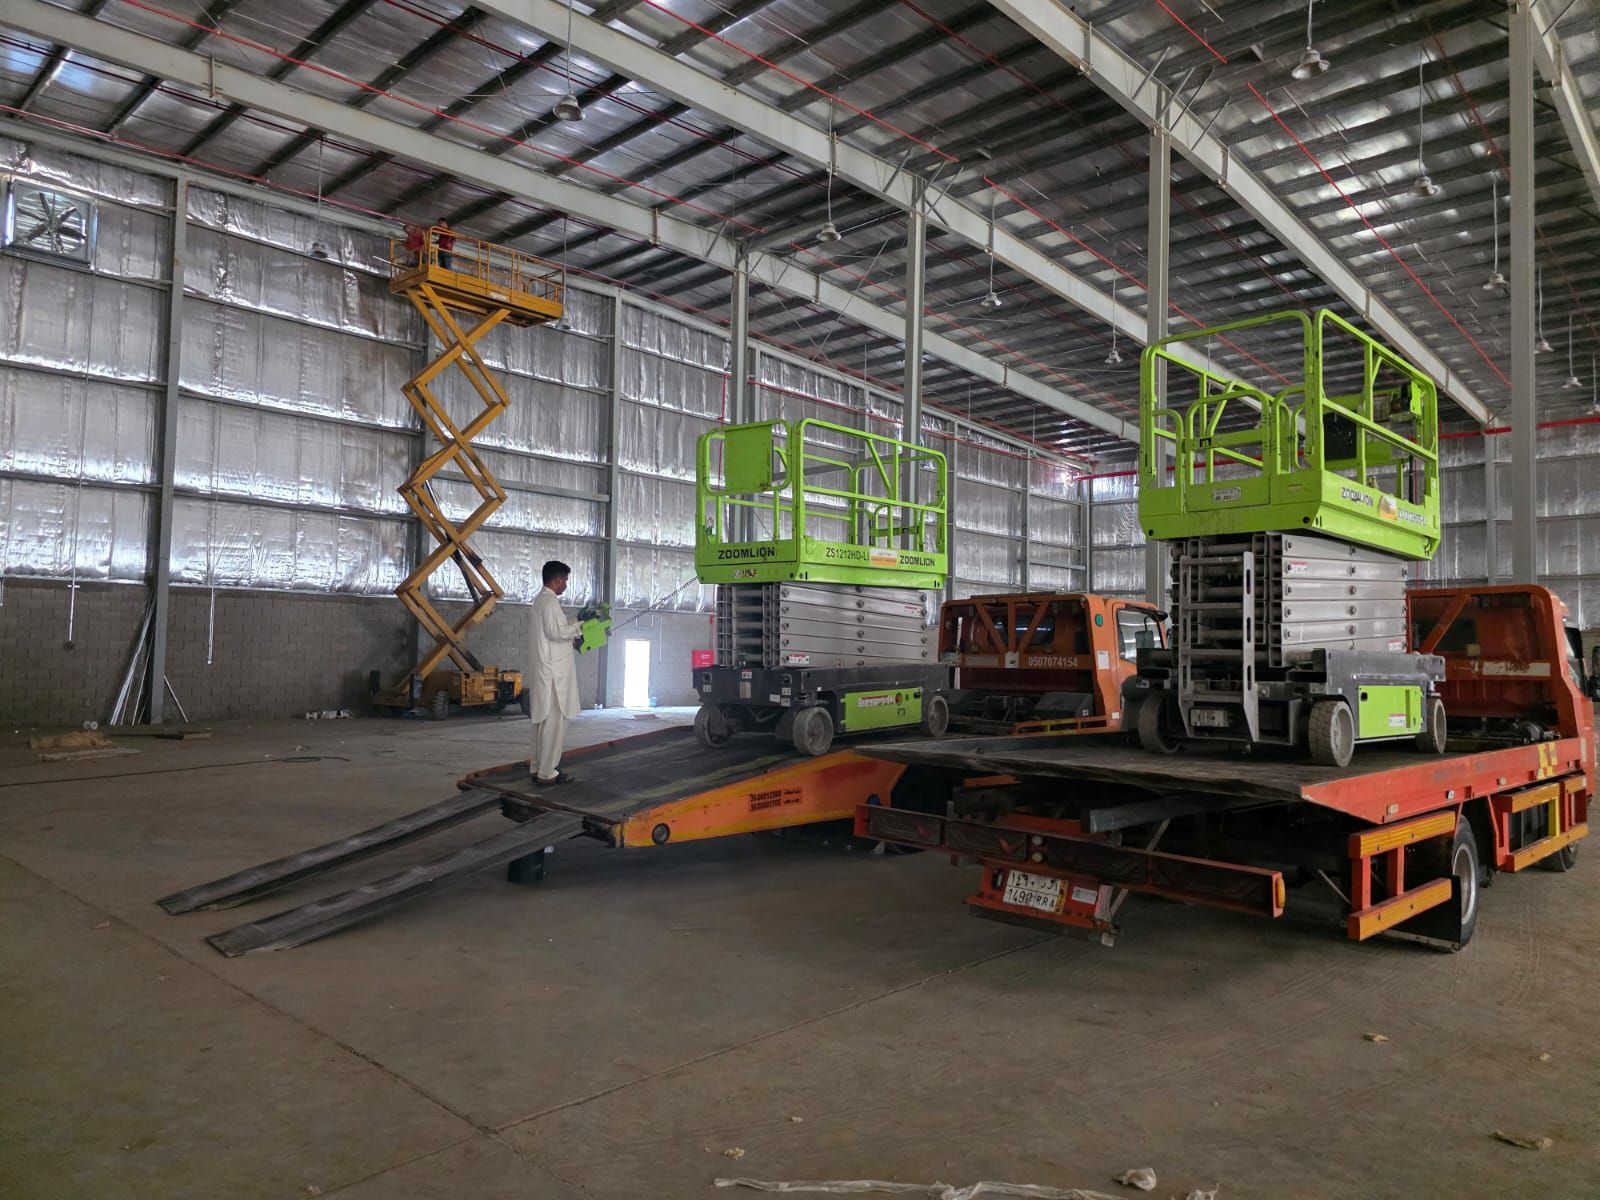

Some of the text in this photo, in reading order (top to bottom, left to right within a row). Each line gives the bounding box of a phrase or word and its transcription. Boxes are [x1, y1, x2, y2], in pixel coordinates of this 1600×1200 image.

[718, 546, 775, 560] ZOOMLION
[899, 555, 935, 567] ZOOMLION
[1028, 656, 1078, 668] 0507074154
